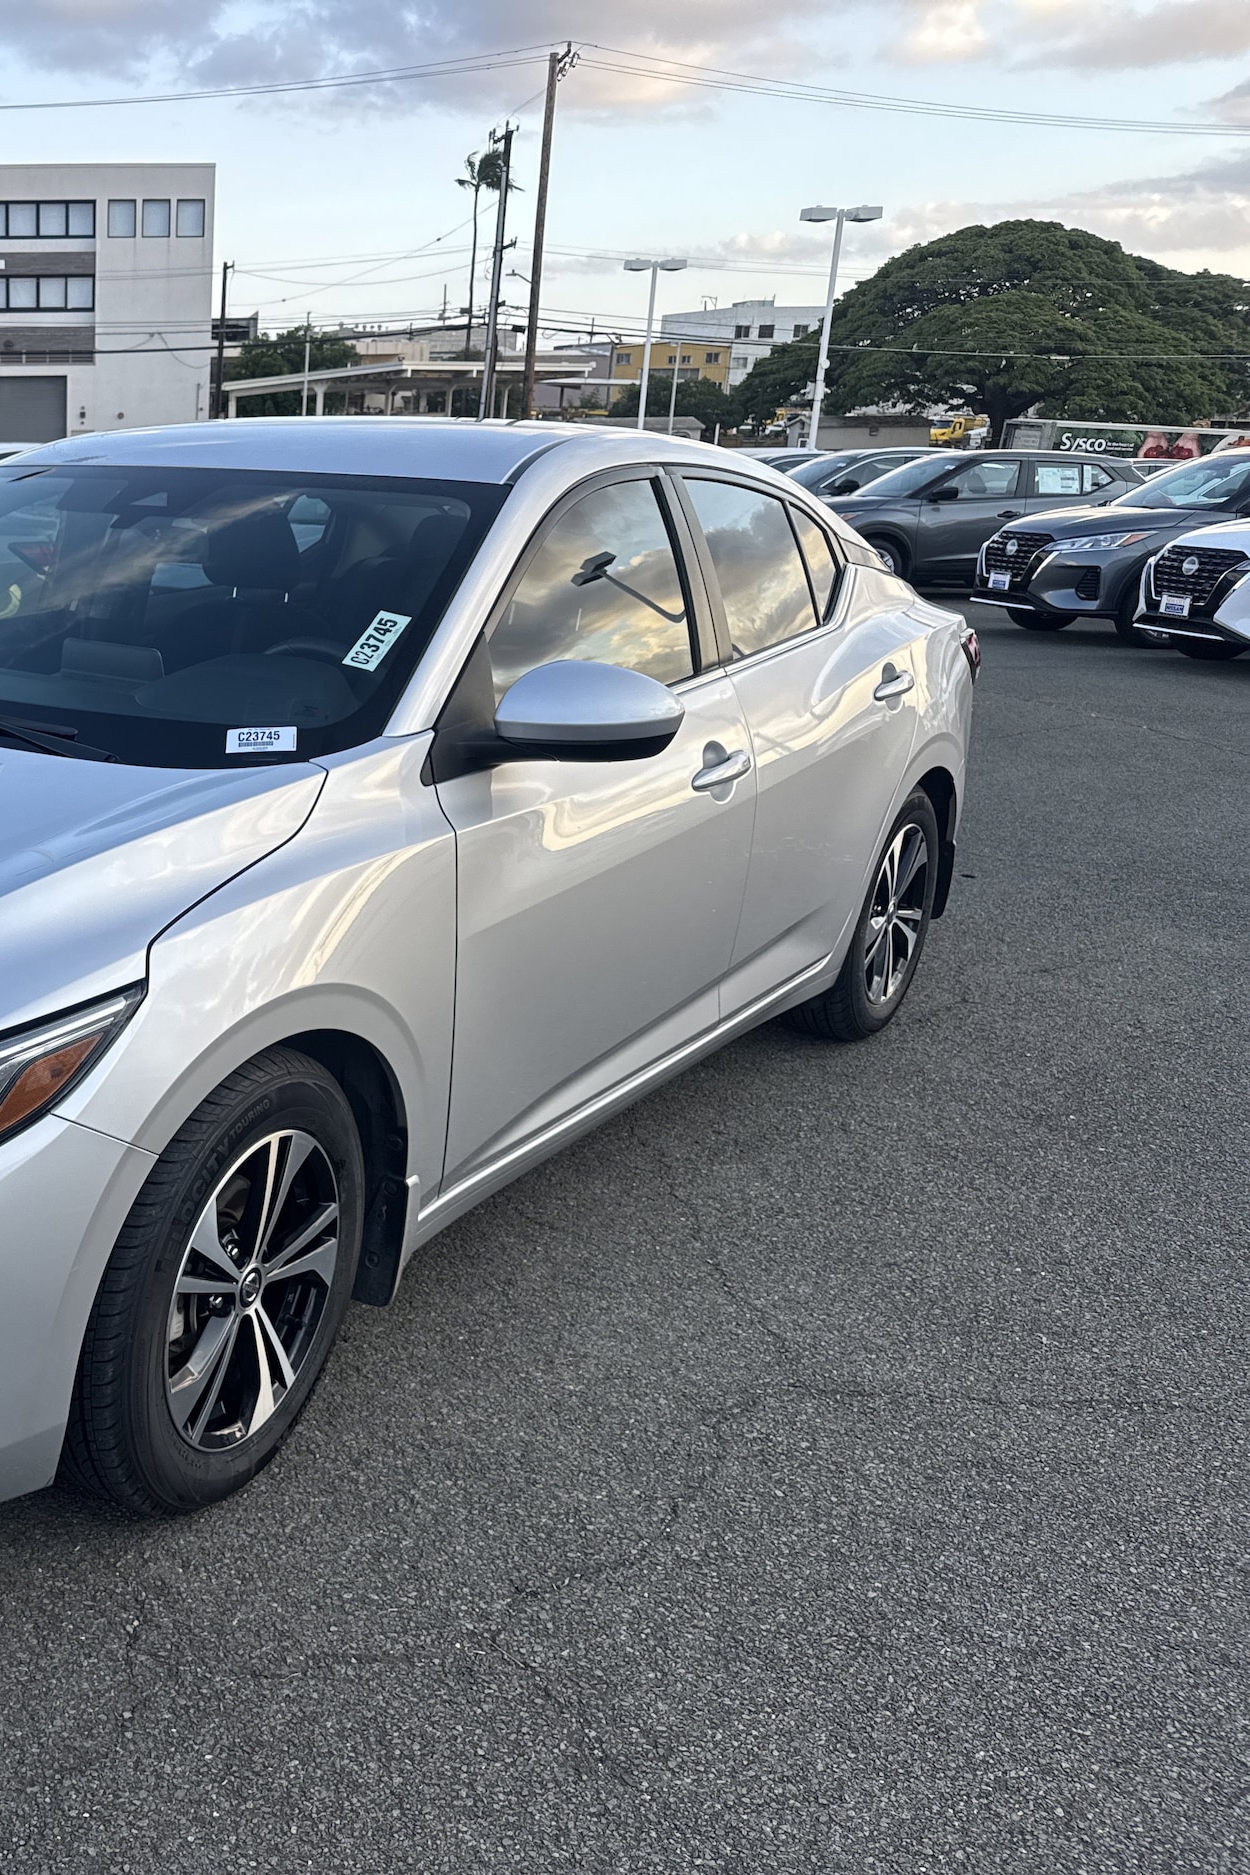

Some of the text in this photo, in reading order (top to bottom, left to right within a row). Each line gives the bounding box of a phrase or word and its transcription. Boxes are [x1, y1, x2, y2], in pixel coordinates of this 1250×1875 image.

[350, 617, 398, 665] C23745
[237, 730, 280, 742] C23745
[230, 1098, 271, 1140] TOURING
